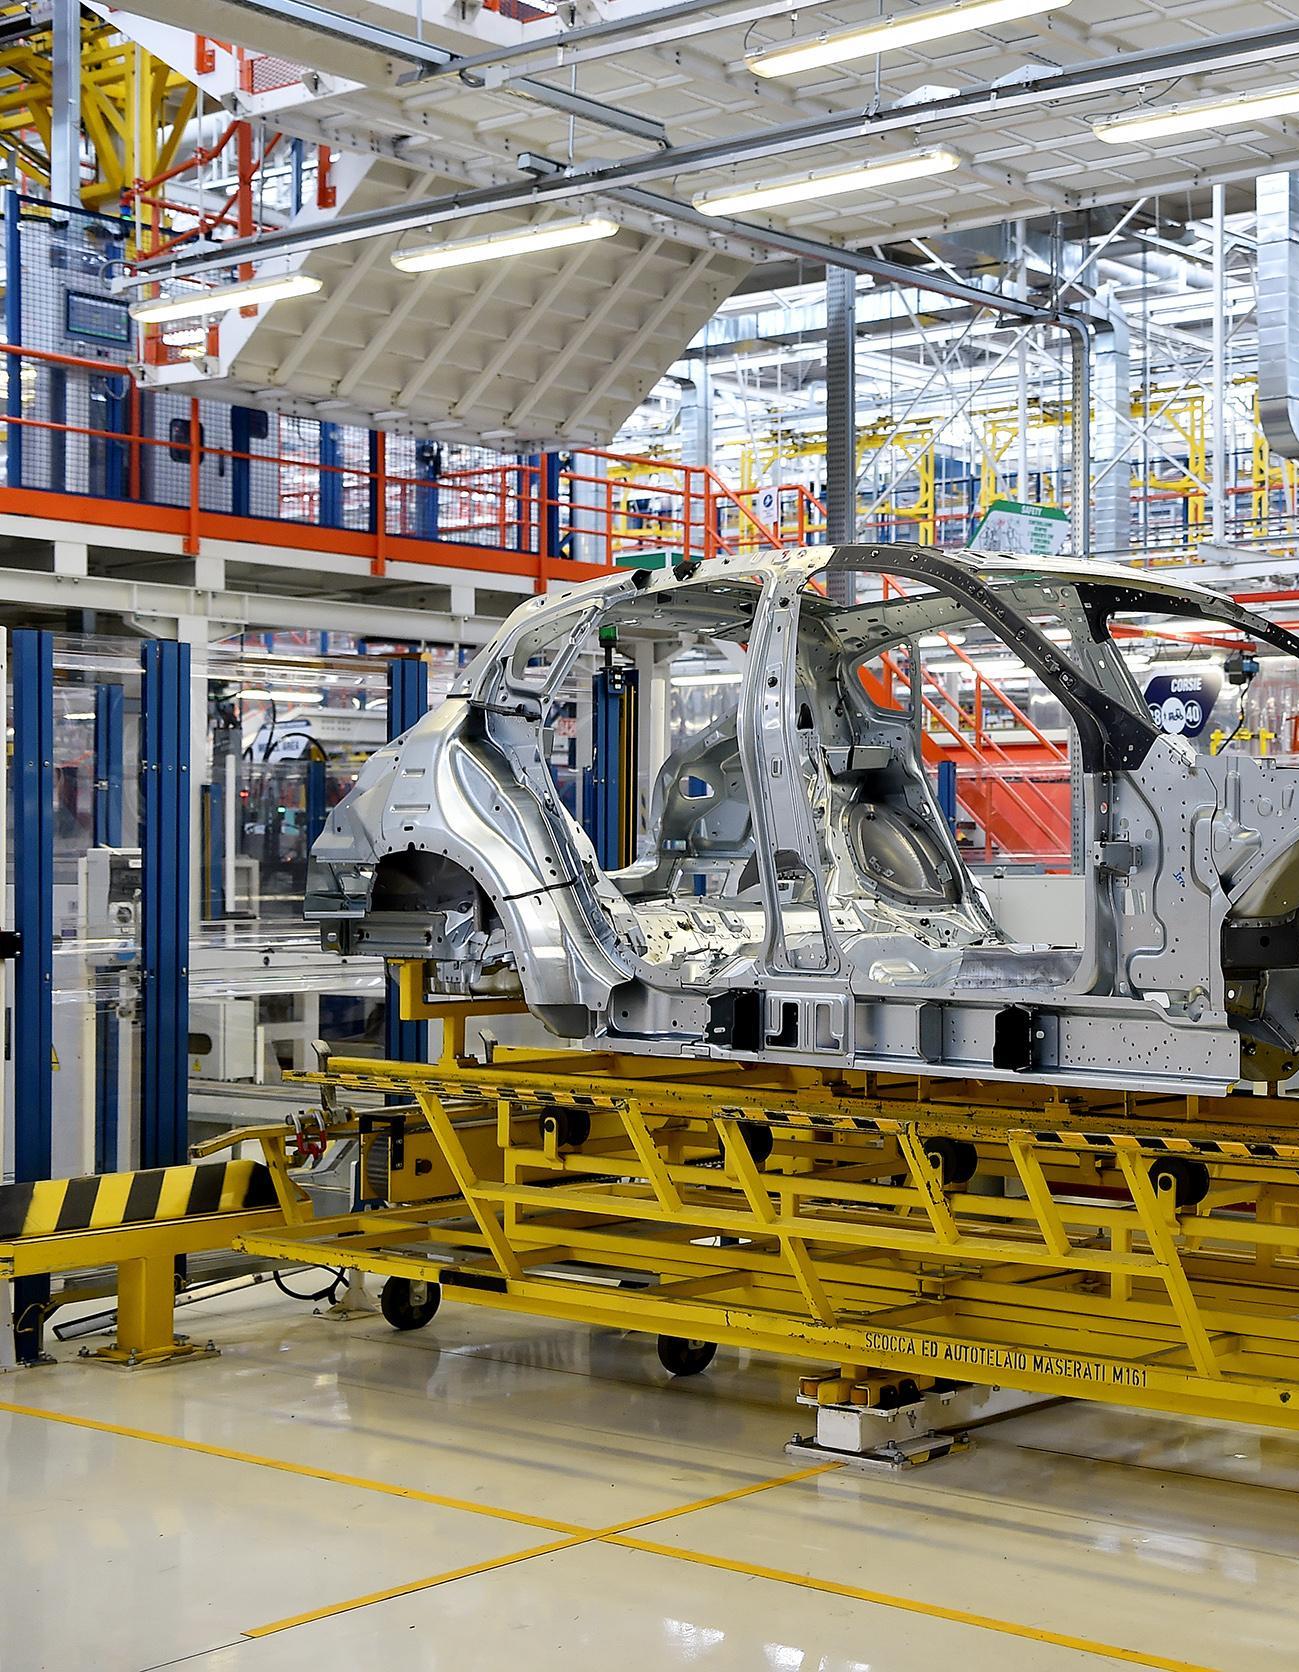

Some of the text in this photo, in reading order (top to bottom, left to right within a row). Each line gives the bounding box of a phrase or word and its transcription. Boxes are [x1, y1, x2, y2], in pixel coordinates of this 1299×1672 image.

[1021, 505, 1043, 516] SAFETY
[1171, 677, 1202, 693] CORSIE
[1186, 706, 1199, 722] 40
[865, 1332, 1147, 1388] SCOCCA ED AUTOTELAIO MASERATI M161
